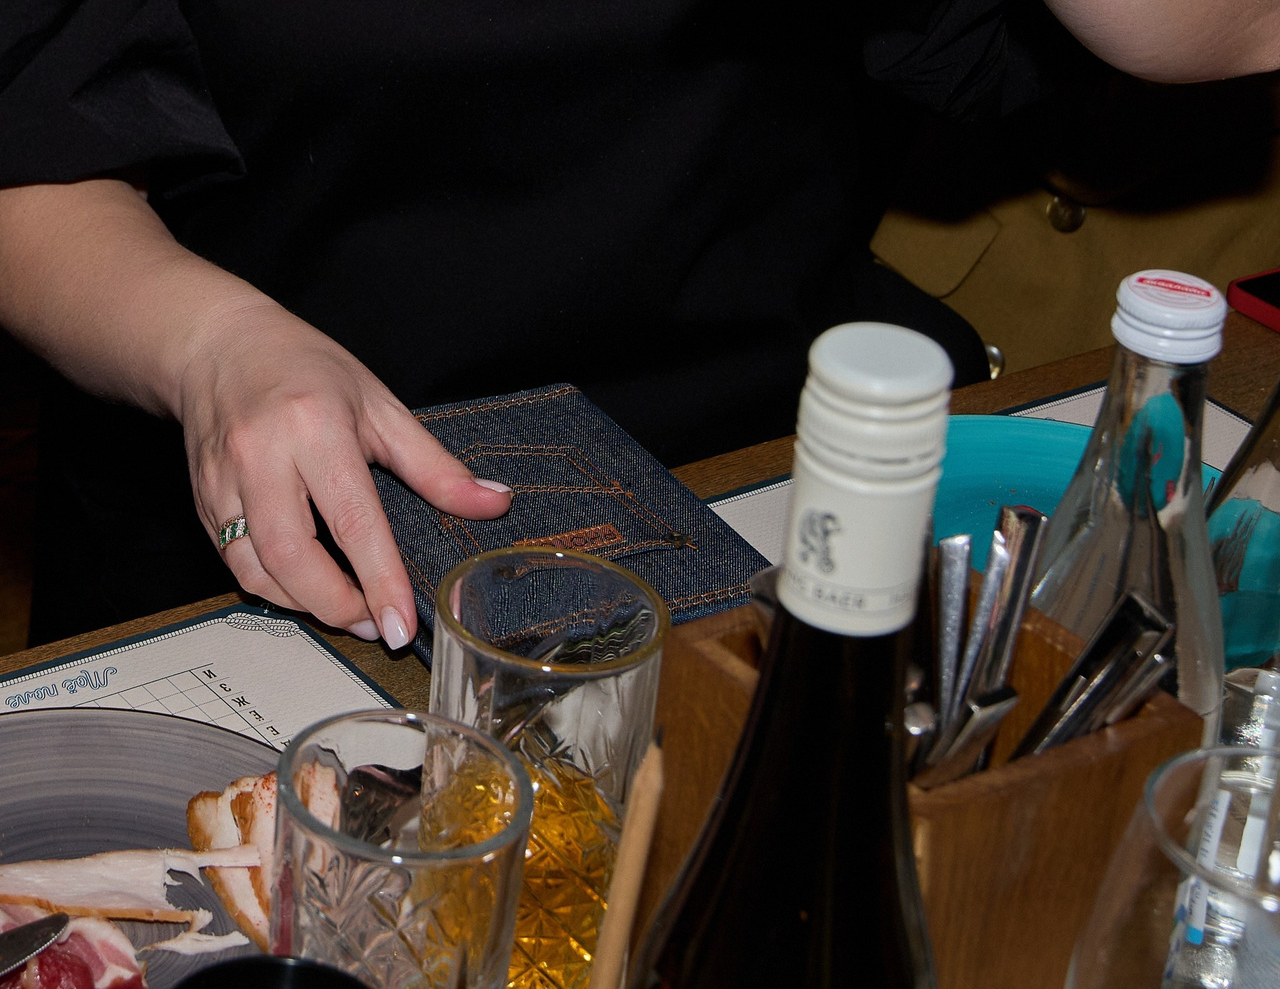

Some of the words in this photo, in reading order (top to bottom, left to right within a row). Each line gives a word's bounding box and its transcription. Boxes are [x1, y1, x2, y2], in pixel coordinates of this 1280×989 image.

[202, 669, 217, 679] И
[62, 666, 118, 694] Моё
[219, 683, 232, 692] З
[5, 684, 59, 709] поле
[231, 696, 251, 707] Ж
[249, 710, 265, 722] Ё
[266, 725, 280, 736] Е
